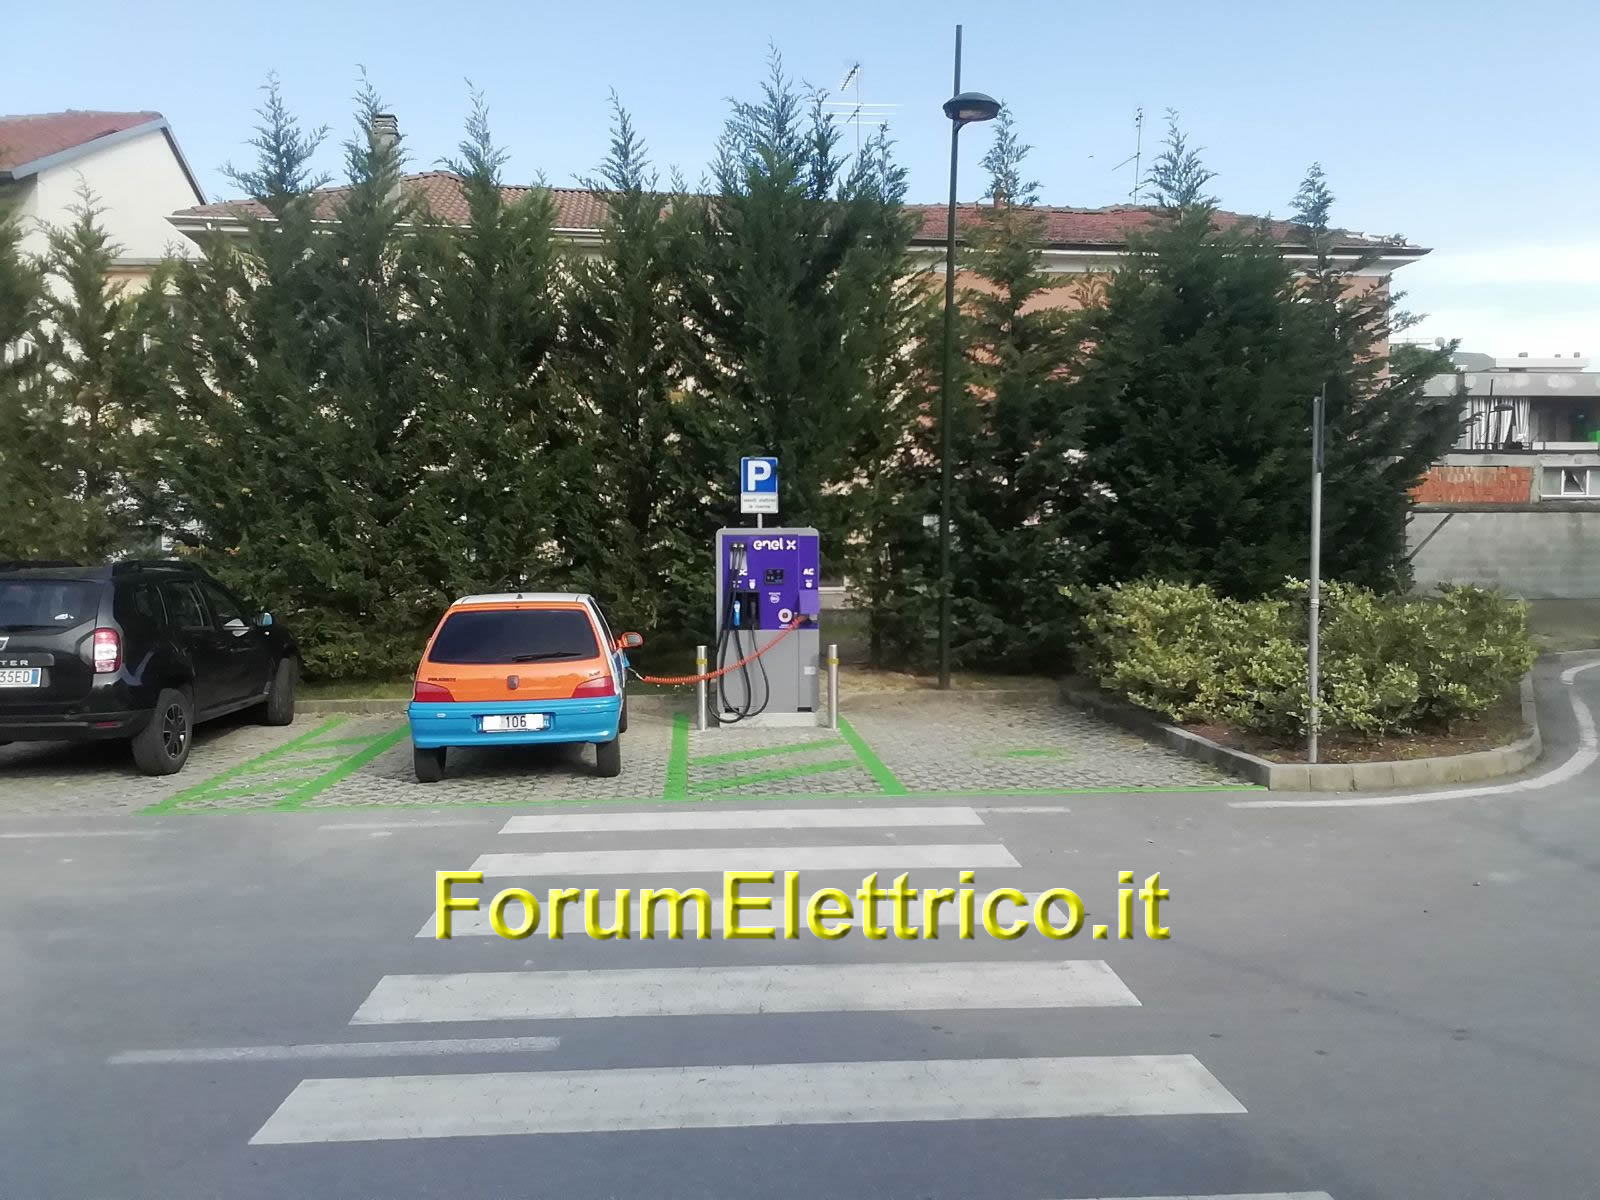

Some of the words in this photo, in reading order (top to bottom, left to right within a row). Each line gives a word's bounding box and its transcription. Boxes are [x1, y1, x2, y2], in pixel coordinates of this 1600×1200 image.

[747, 460, 771, 491] P
[753, 538, 784, 550] enel
[803, 567, 815, 576] AC
[505, 715, 527, 728] 106
